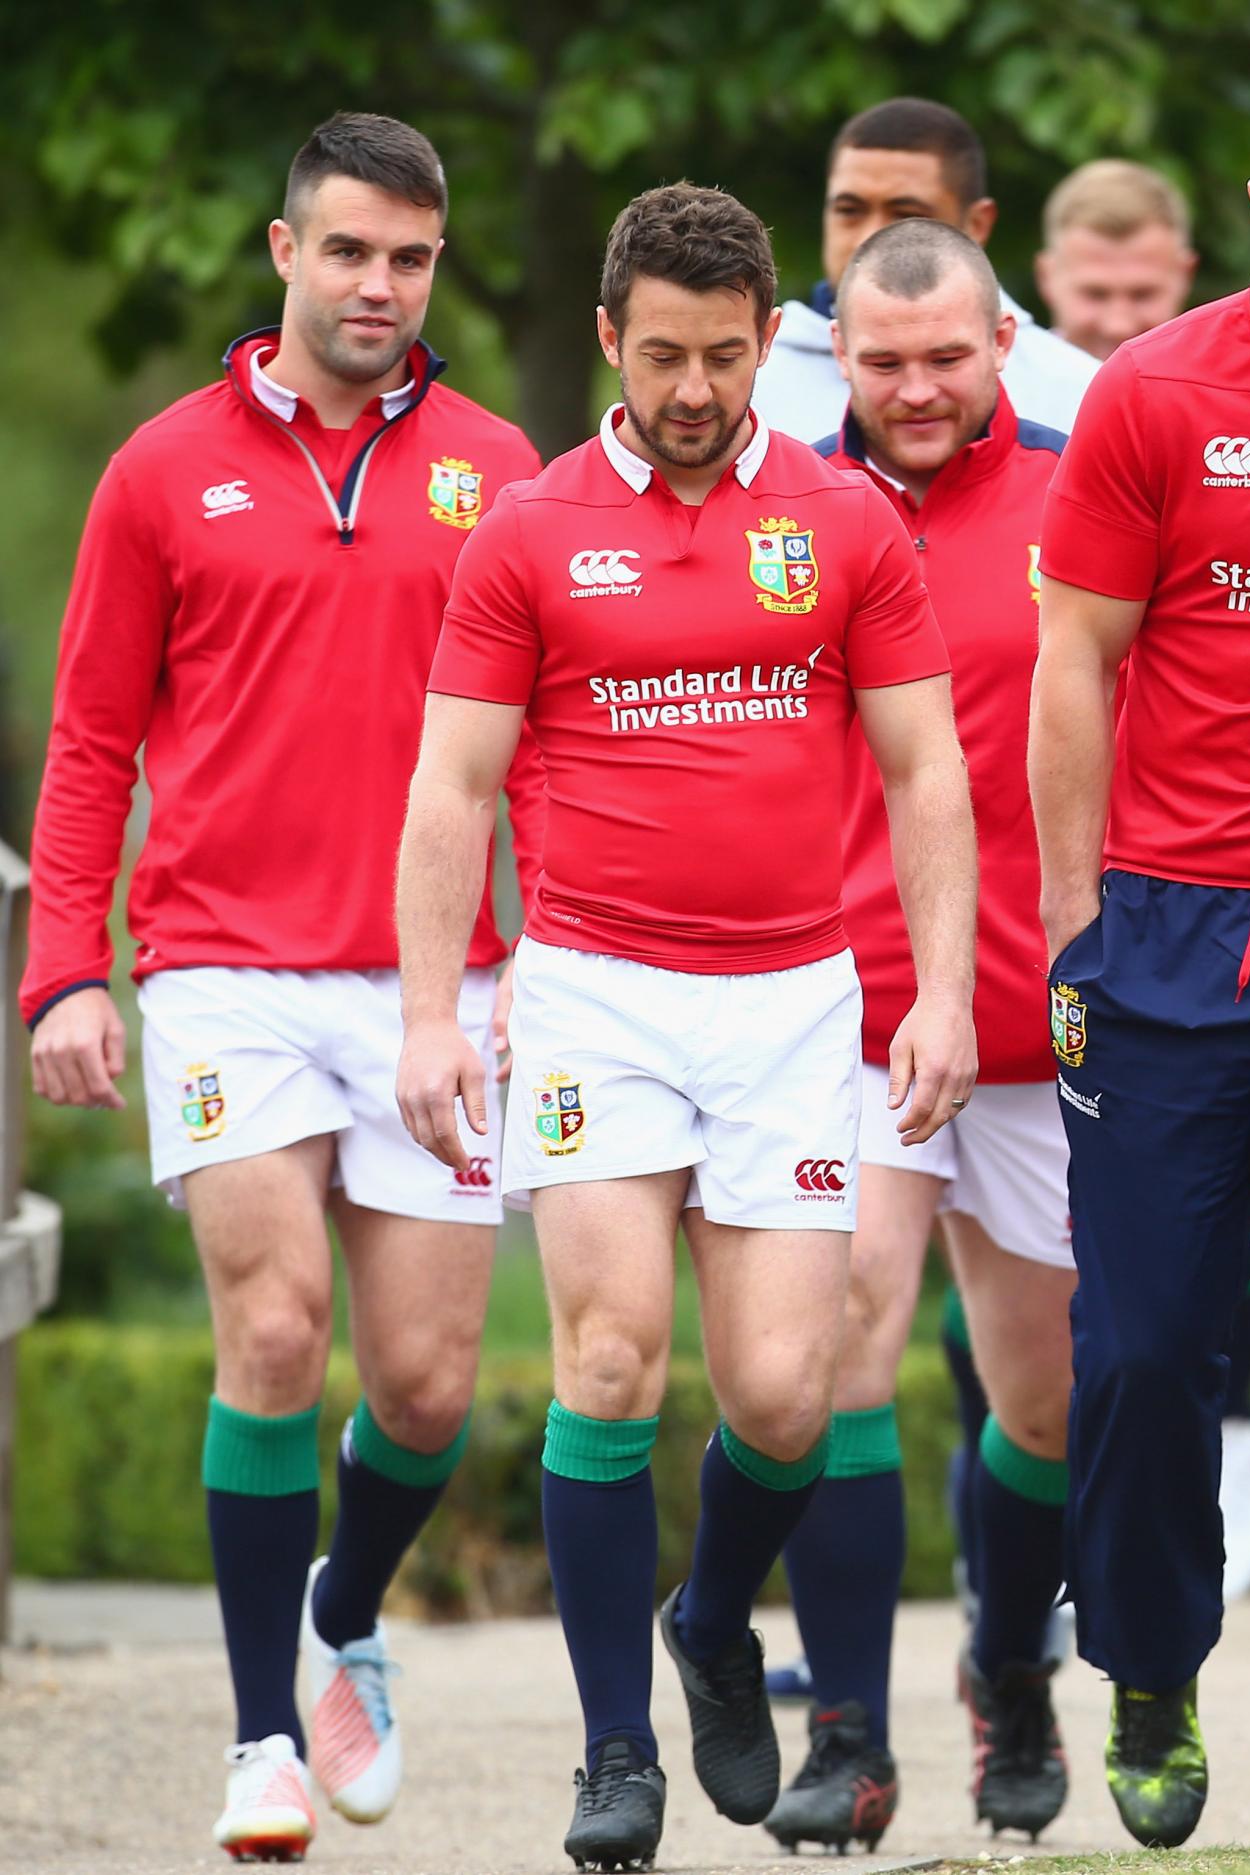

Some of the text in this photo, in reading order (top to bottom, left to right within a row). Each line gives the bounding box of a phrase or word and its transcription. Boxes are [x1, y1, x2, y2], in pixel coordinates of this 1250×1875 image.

[569, 582, 643, 598] canterbury
[589, 664, 808, 704] Standard Life
[609, 694, 808, 732] Investments
[794, 1193, 846, 1205] canterbury
